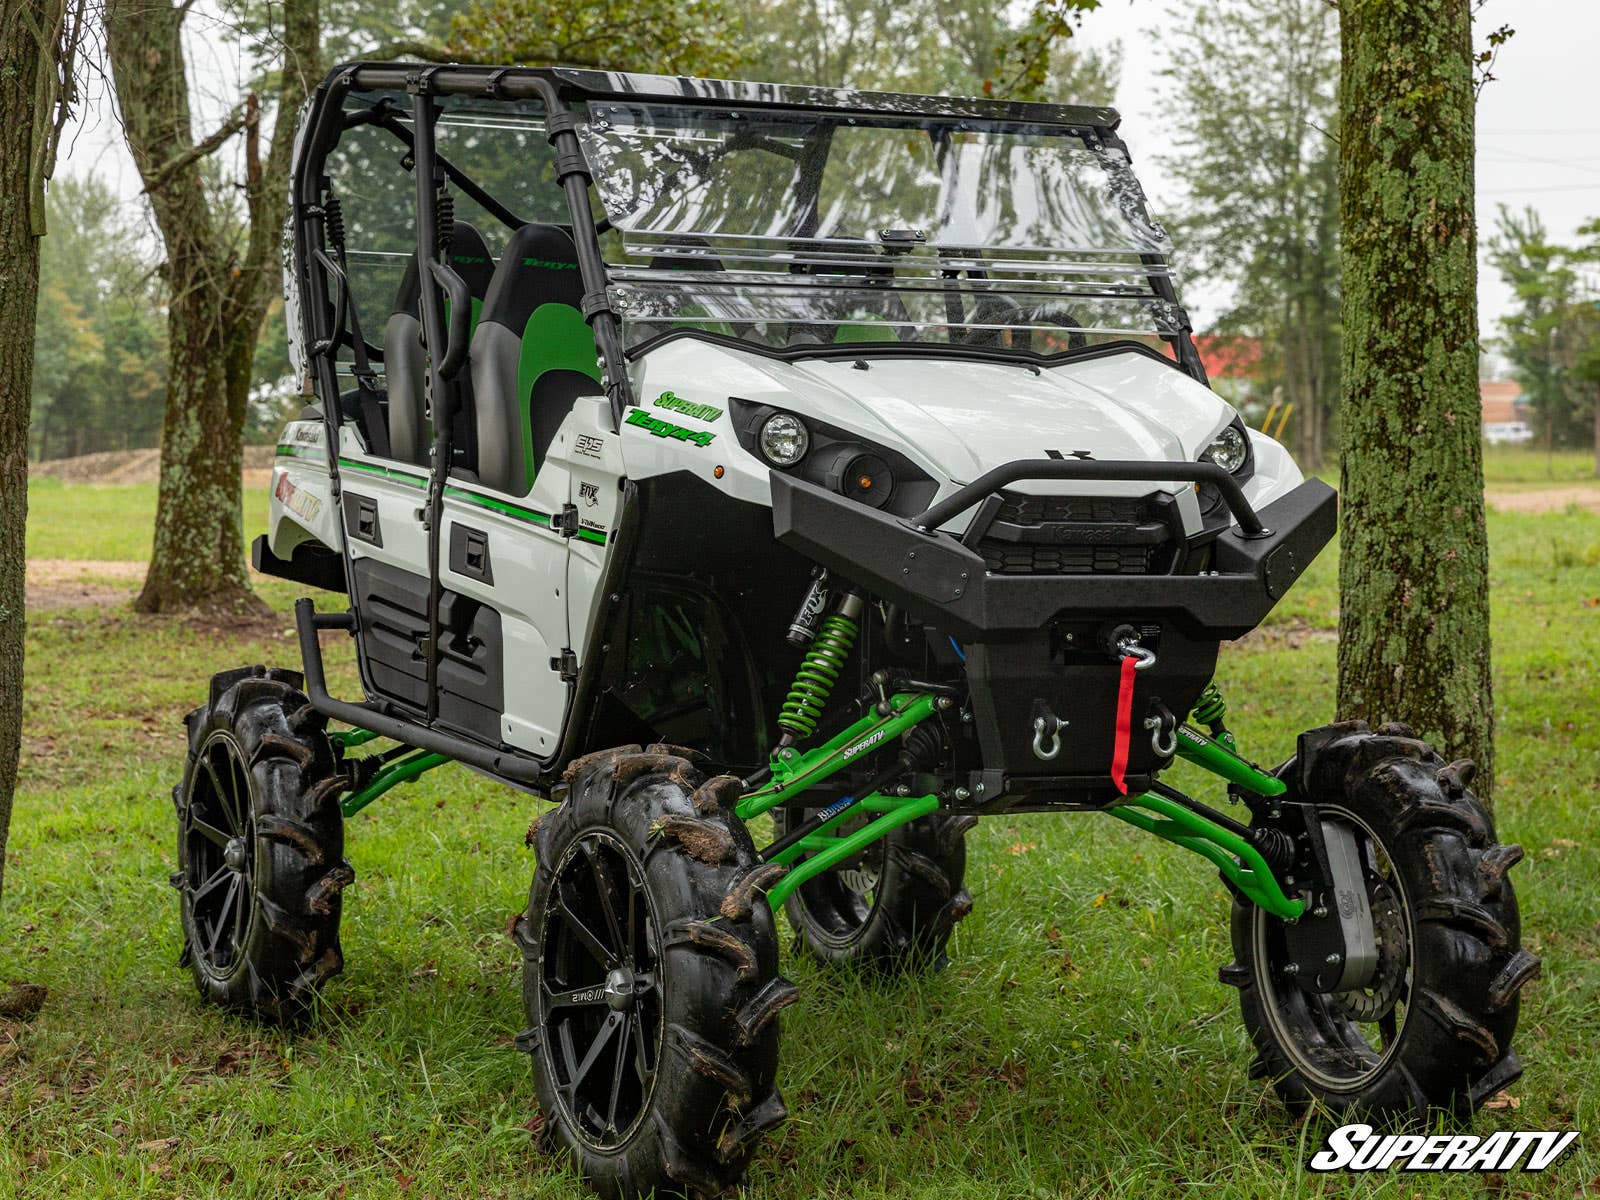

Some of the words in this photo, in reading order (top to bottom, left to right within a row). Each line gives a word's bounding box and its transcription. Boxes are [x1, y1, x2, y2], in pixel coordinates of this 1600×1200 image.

[653, 390, 724, 423] SUPERATV
[579, 481, 599, 501] FOX
[800, 583, 822, 626] FOX
[842, 730, 885, 760] SUPERATV
